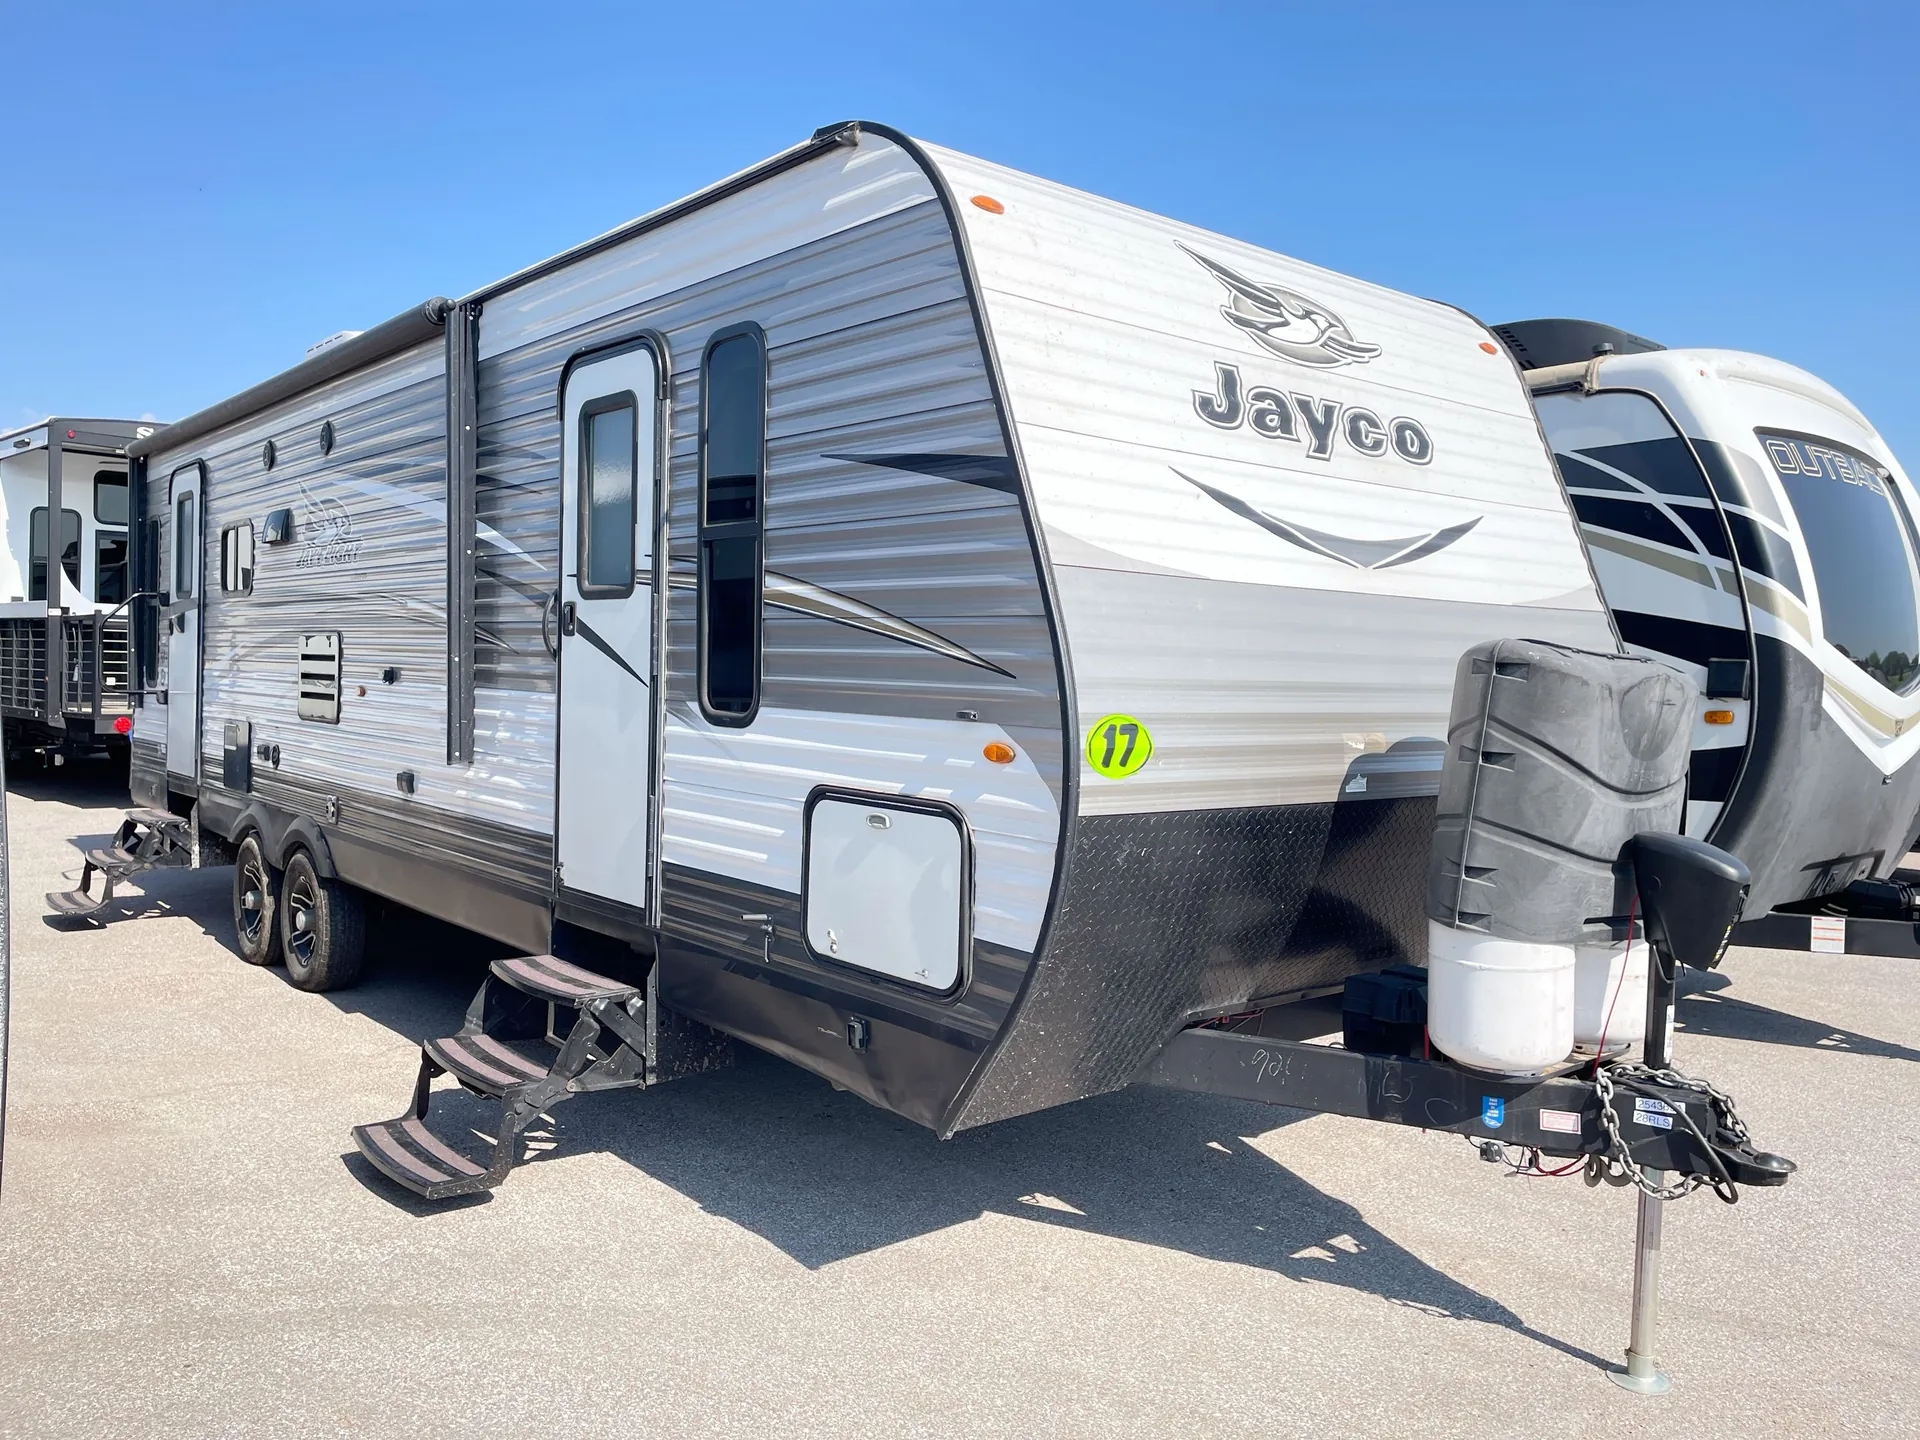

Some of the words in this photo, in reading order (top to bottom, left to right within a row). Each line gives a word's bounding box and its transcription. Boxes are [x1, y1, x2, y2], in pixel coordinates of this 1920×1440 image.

[1191, 360, 1434, 466] Jayco
[1766, 440, 1886, 496] OUTBAC
[1101, 723, 1139, 768] 17
[1636, 1112, 1670, 1128] 28RLS
